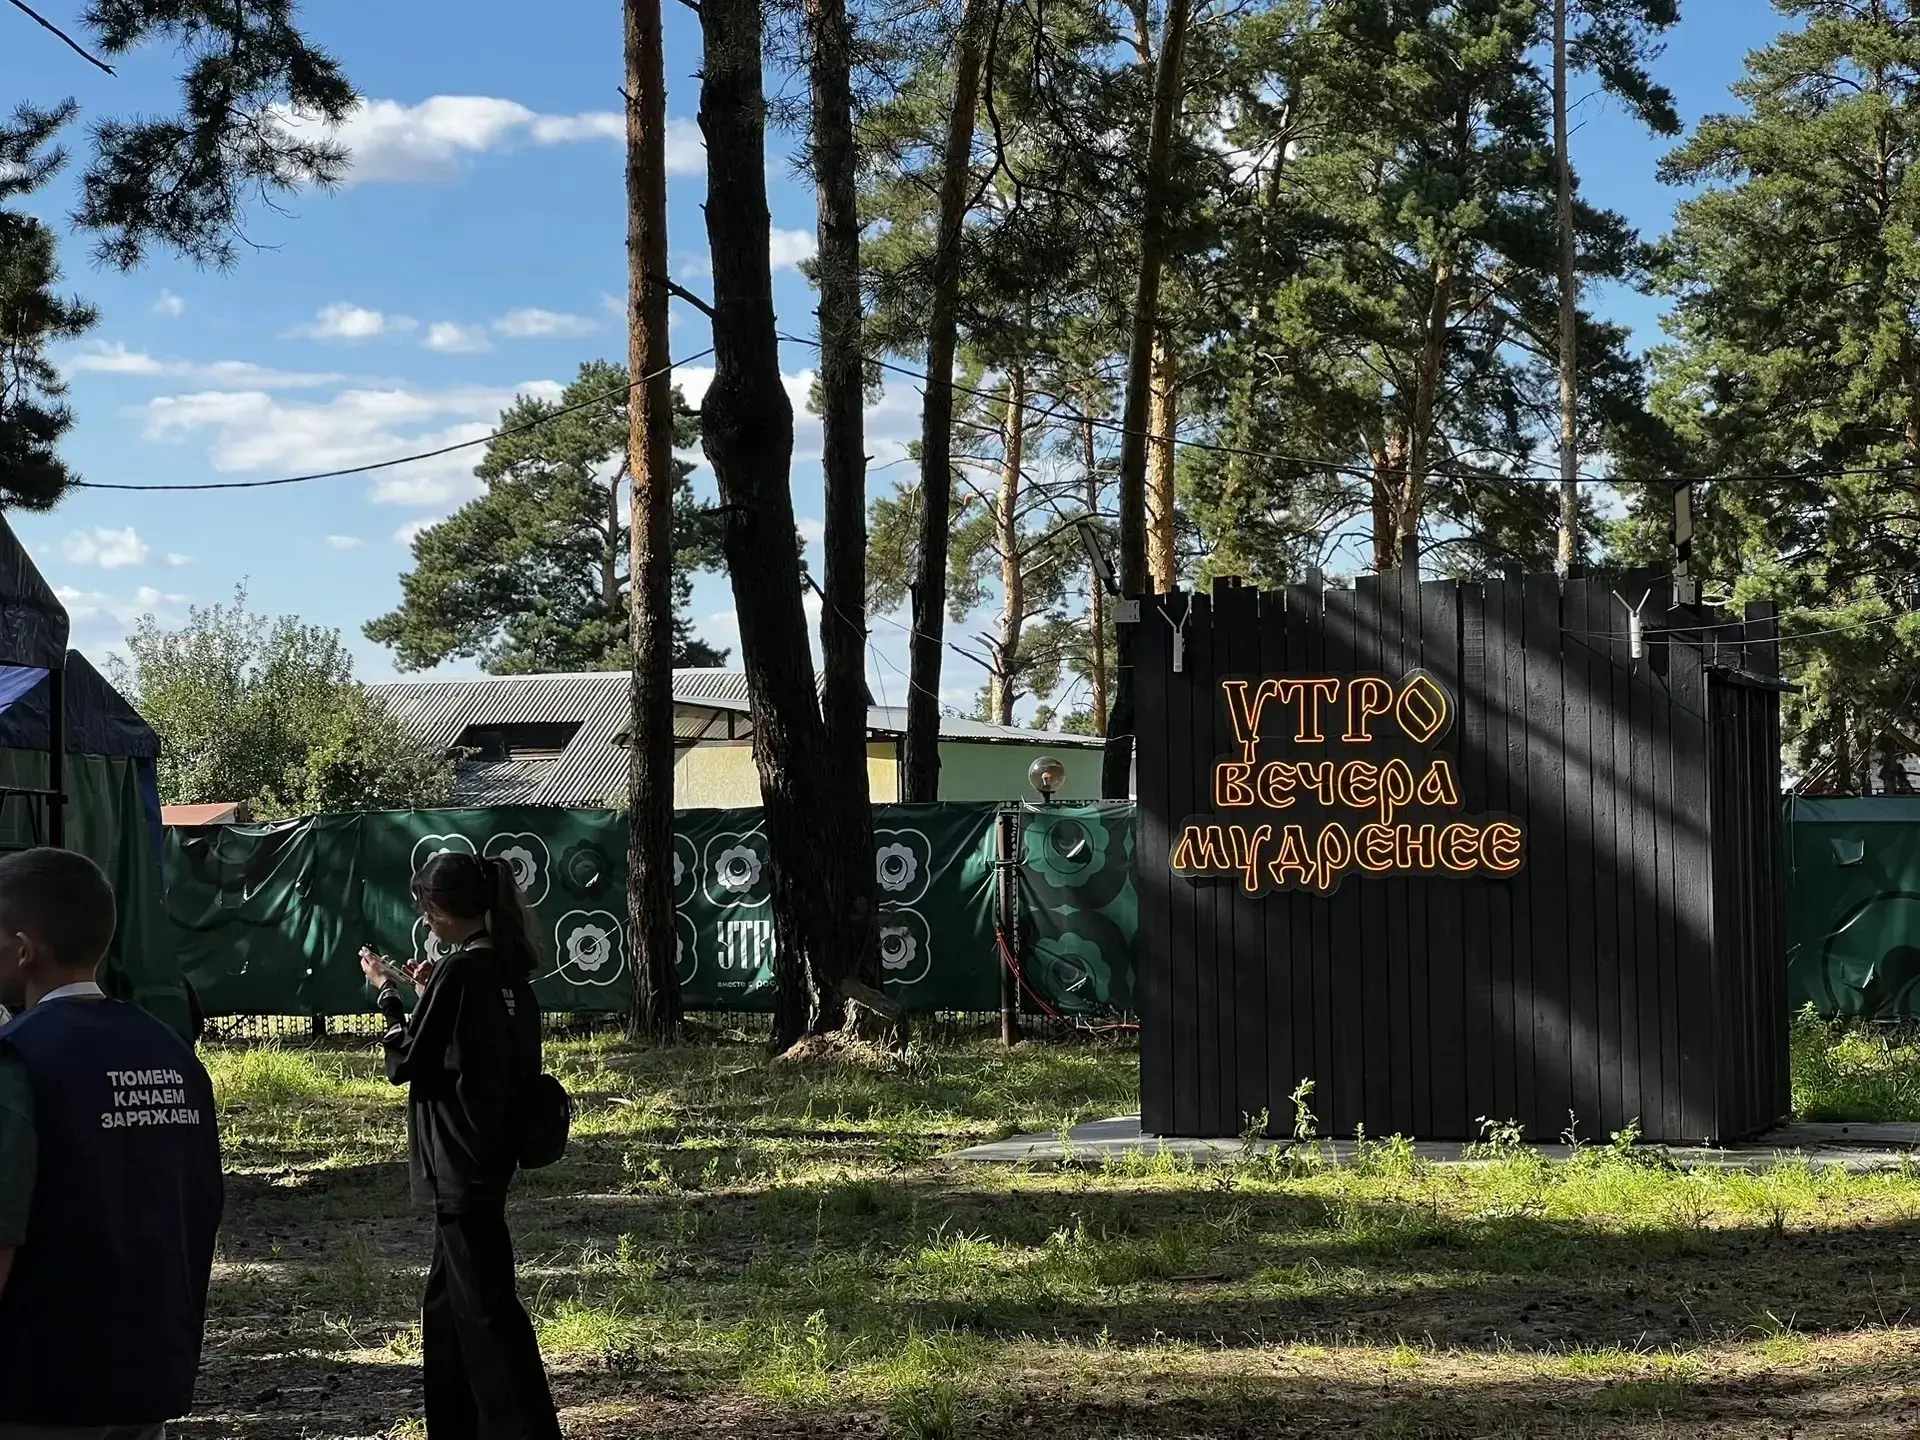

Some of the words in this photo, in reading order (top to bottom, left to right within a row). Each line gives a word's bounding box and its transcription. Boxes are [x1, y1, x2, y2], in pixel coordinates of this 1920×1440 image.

[1222, 676, 1446, 764] УТРО
[1216, 758, 1458, 826] ВЕЧЕРА
[1173, 822, 1522, 891] МУДРЕНЕЕ
[106, 1069, 184, 1087] ТЮМЕНЬ
[114, 1088, 186, 1107] КАЧАЕМ
[101, 1109, 200, 1129] ЗАРЯЖАЕМ
